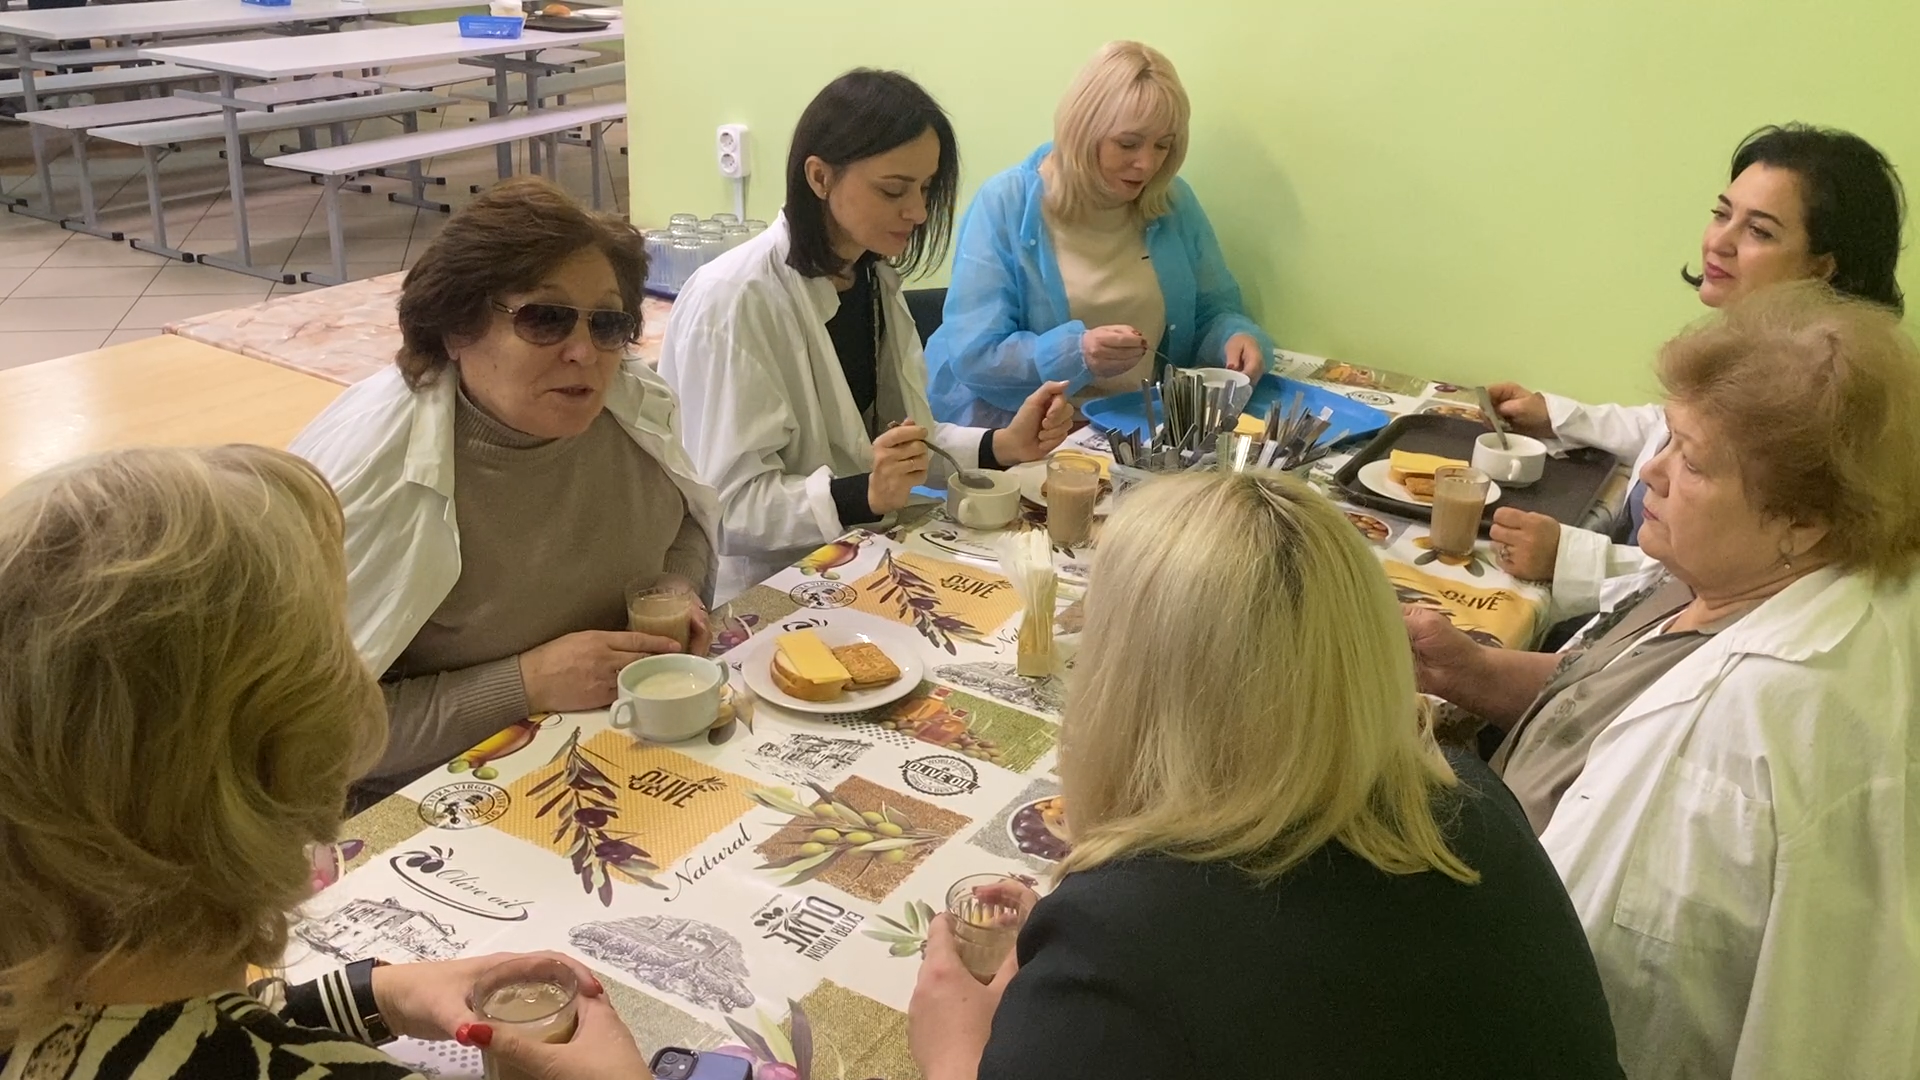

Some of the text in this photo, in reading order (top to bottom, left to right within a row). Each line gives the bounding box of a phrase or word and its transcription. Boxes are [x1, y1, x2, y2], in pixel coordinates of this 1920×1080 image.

[941, 575, 995, 599] OLIVE
[1443, 590, 1499, 611] OLIVE
[628, 770, 699, 809] OLIVE
[906, 761, 971, 792] OLIVE OIL
[664, 822, 752, 902] Natural
[435, 869, 535, 909] Olive oil
[762, 895, 846, 954] OLIVE
[803, 911, 865, 962] EXTRA VIRGIN
